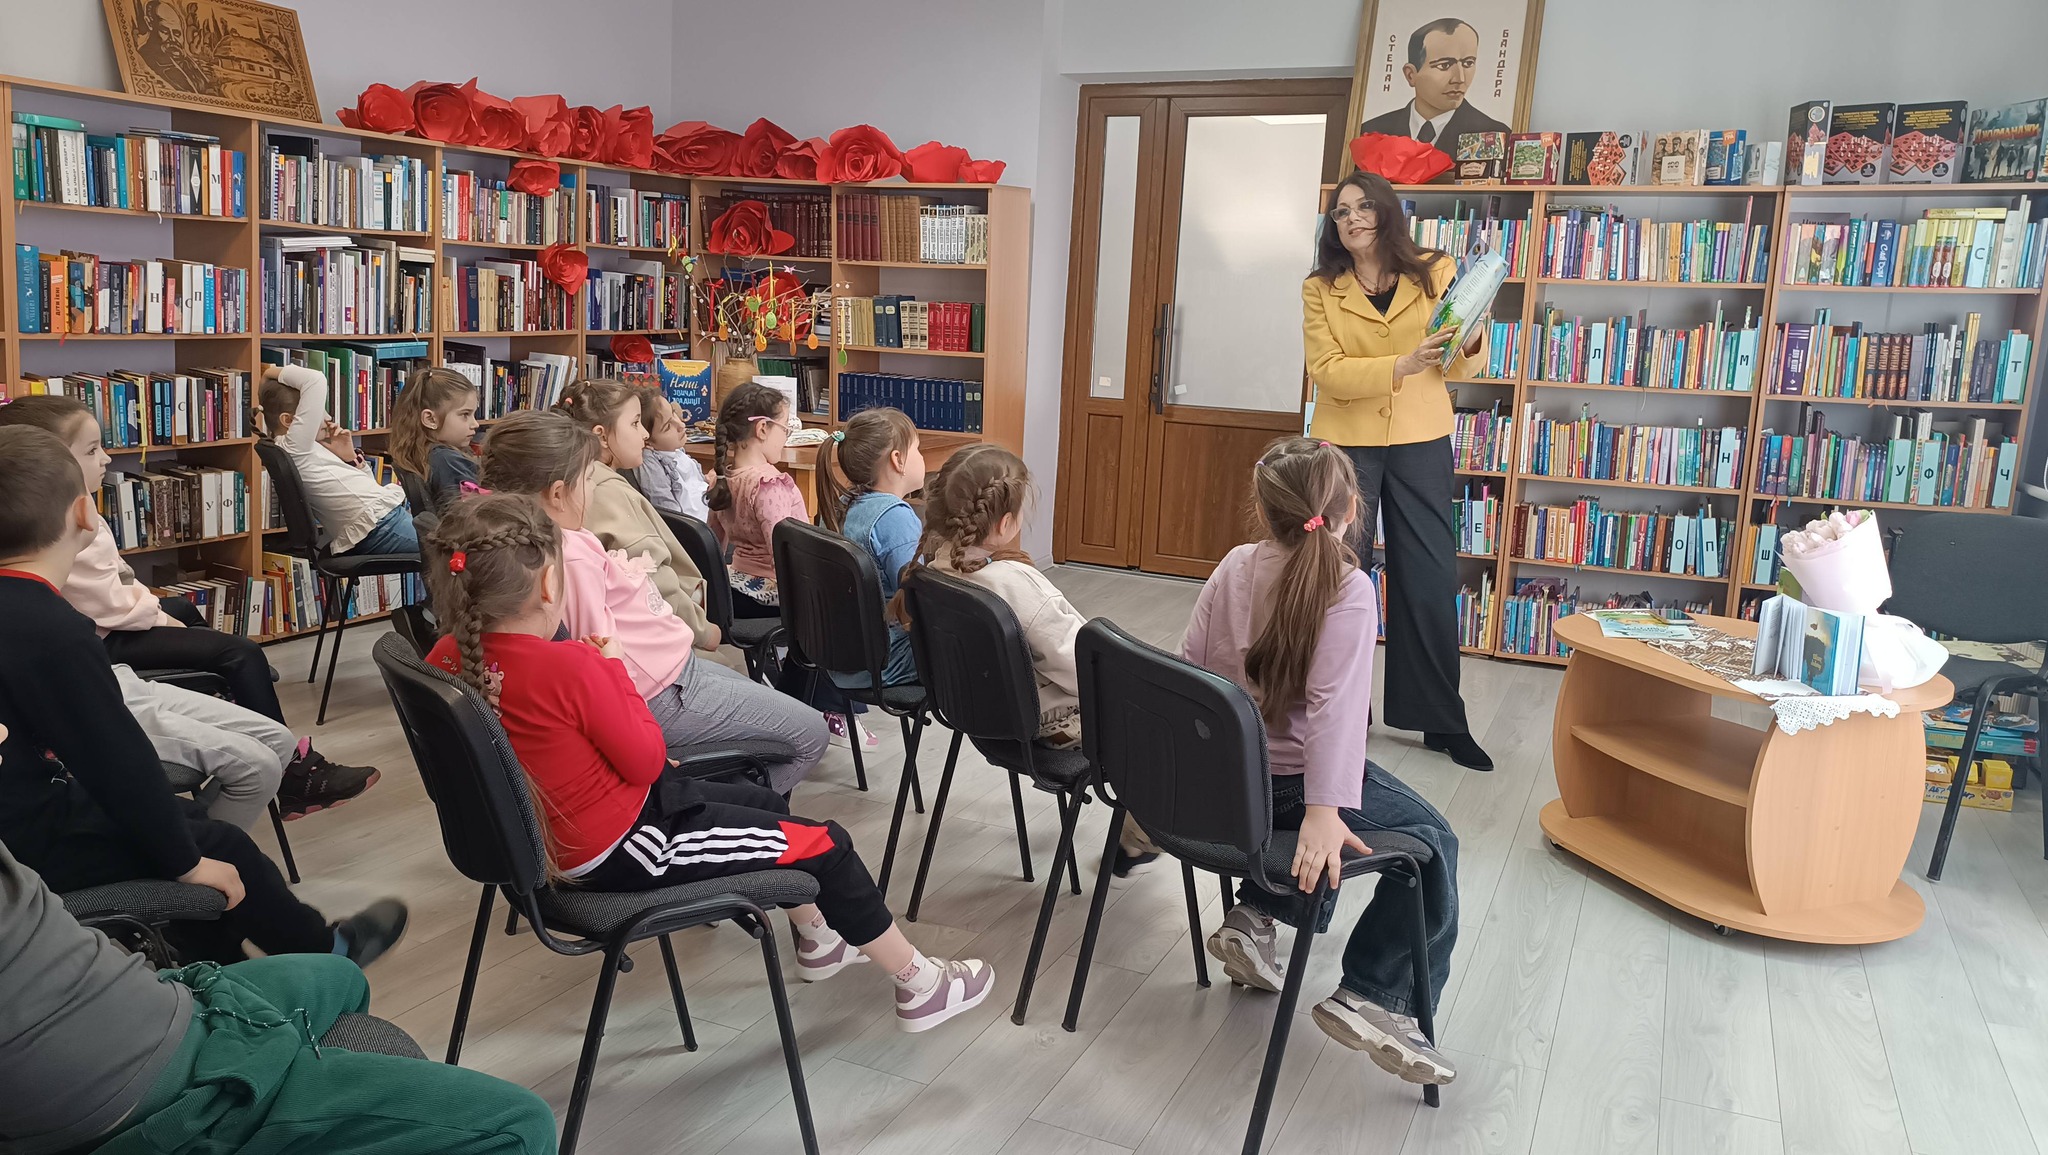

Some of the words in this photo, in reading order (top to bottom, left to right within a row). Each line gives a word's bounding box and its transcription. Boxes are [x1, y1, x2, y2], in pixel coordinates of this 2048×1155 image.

[1383, 34, 1397, 92] СТЕПАН
[1493, 29, 1509, 98] БАНДЕРА
[150, 169, 158, 181] Л
[211, 174, 221, 185] М
[1974, 247, 1986, 260] С
[150, 292, 160, 303] Н
[194, 291, 202, 301] П
[1592, 348, 1602, 360] Л
[1740, 355, 1749, 366] М
[2011, 360, 2022, 373] Т
[178, 401, 187, 412] С
[1721, 452, 1731, 464] Н
[1896, 465, 1906, 477] У
[1924, 467, 1934, 480] Ф
[2001, 468, 2009, 481] Ч
[205, 500, 215, 511] У
[222, 498, 233, 508] Ф
[124, 510, 134, 521] Т
[1475, 521, 1483, 534] Е
[1674, 539, 1684, 550] О
[1705, 540, 1715, 553] П
[1761, 550, 1770, 561] Ш
[251, 604, 260, 614] Я
